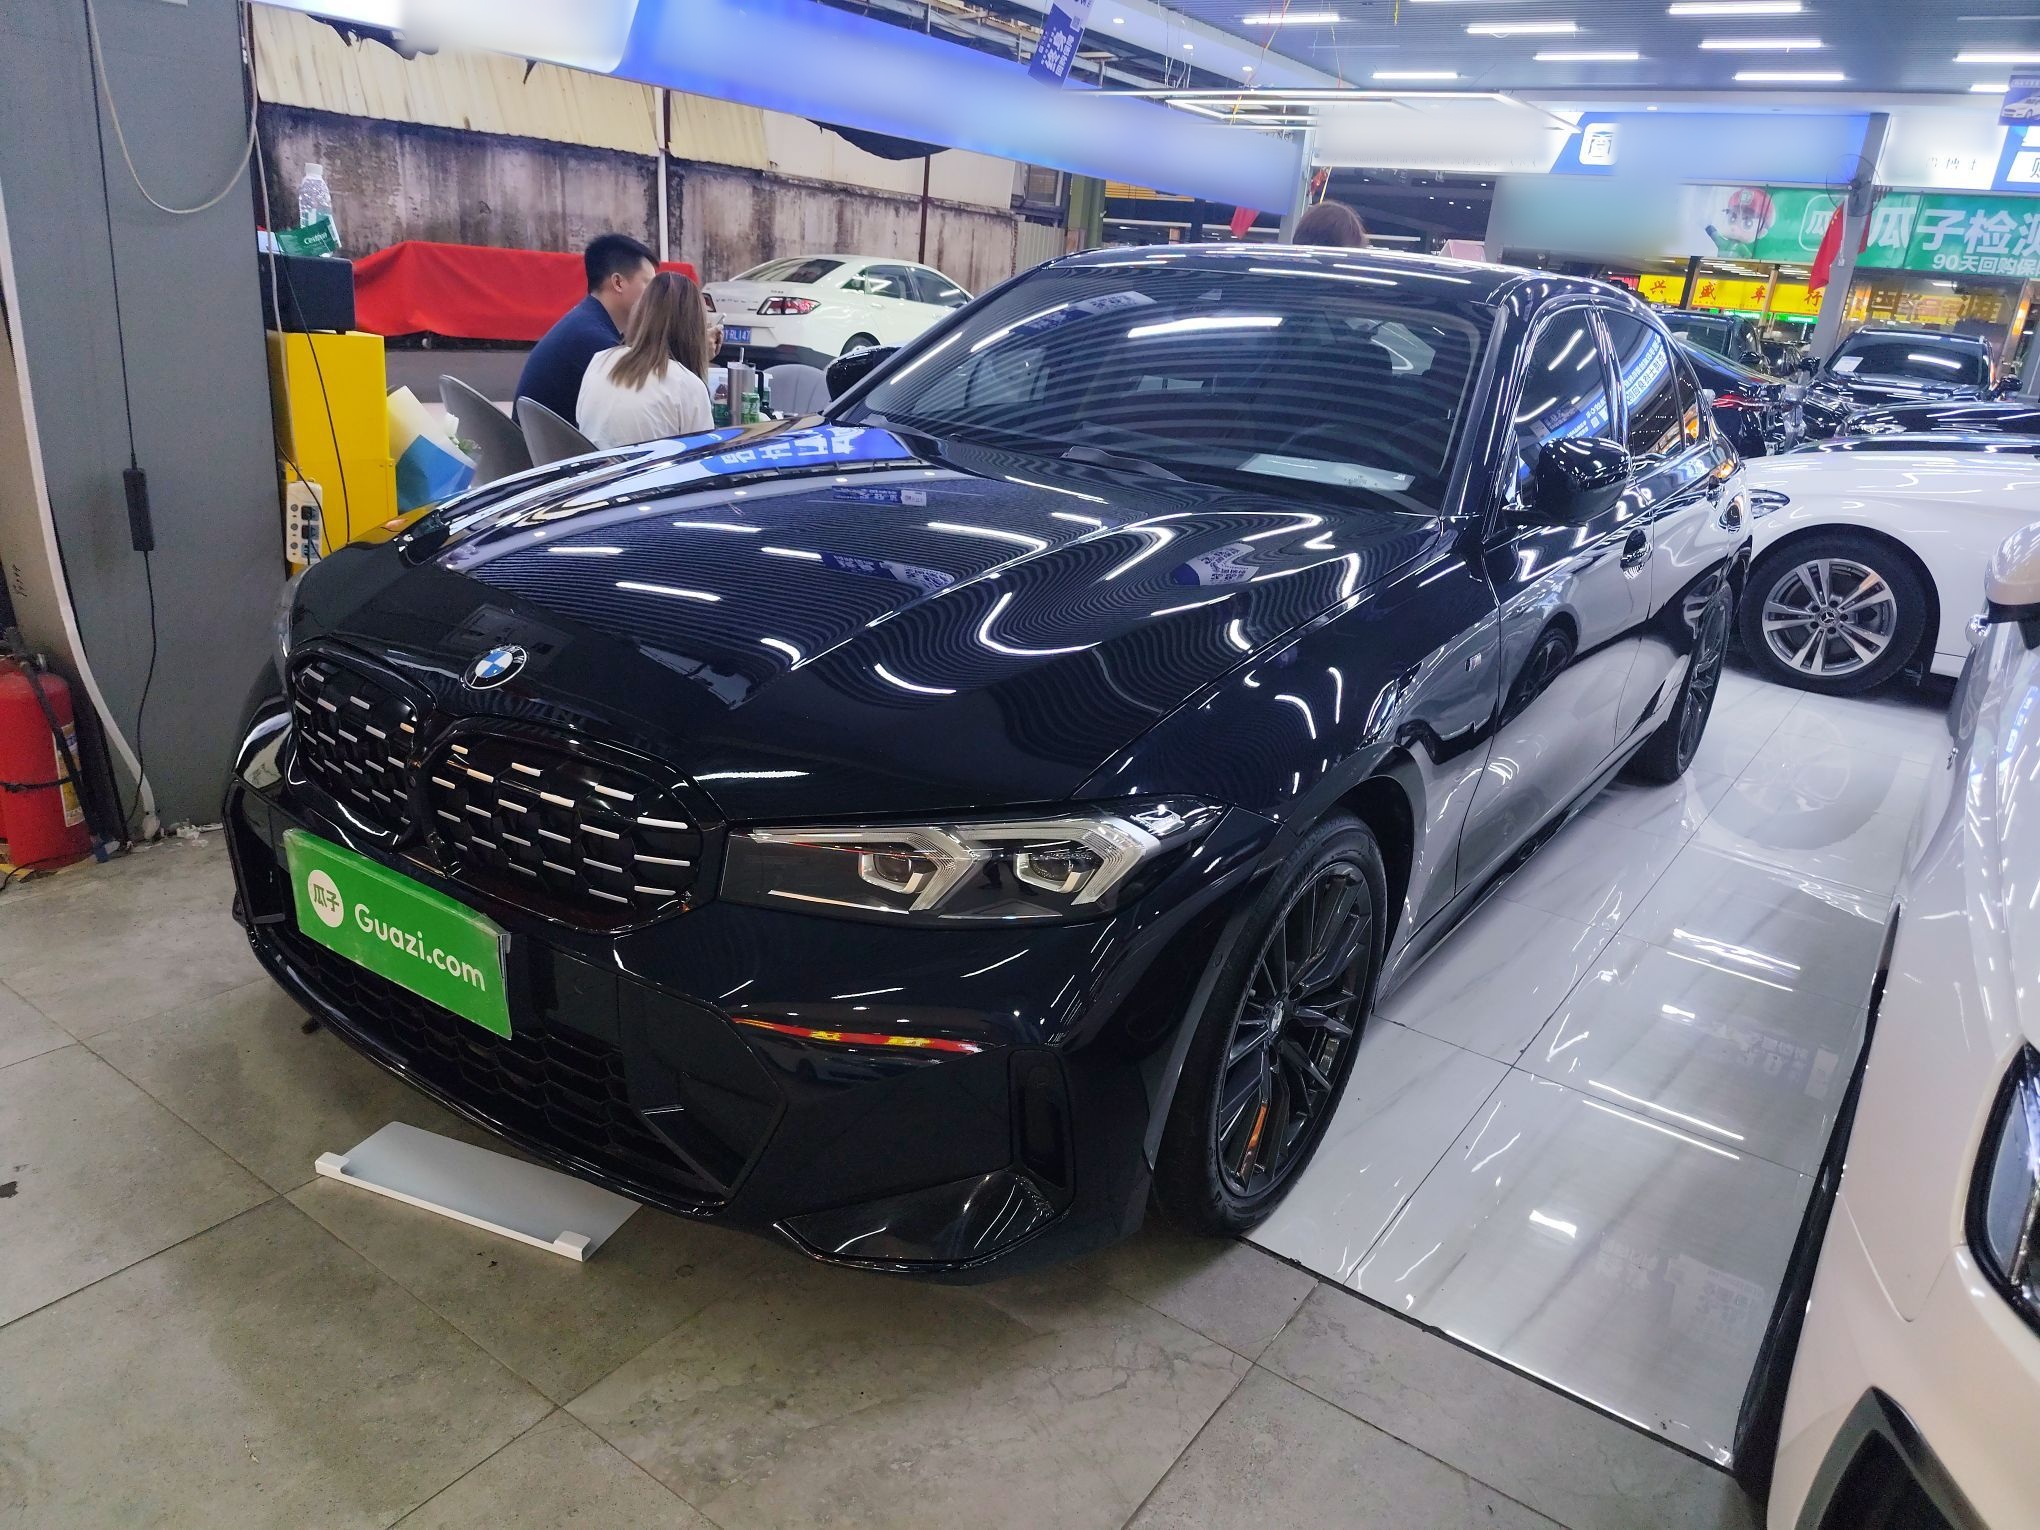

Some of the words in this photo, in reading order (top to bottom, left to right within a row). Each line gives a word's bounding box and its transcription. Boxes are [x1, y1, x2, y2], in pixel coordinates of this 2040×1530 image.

[1805, 210, 1834, 236] 瓜
[1932, 253, 2040, 277] 90天回购保
[725, 329, 751, 341] YRL147
[313, 883, 340, 913] 瓜子
[354, 903, 486, 992] Guazi.com
